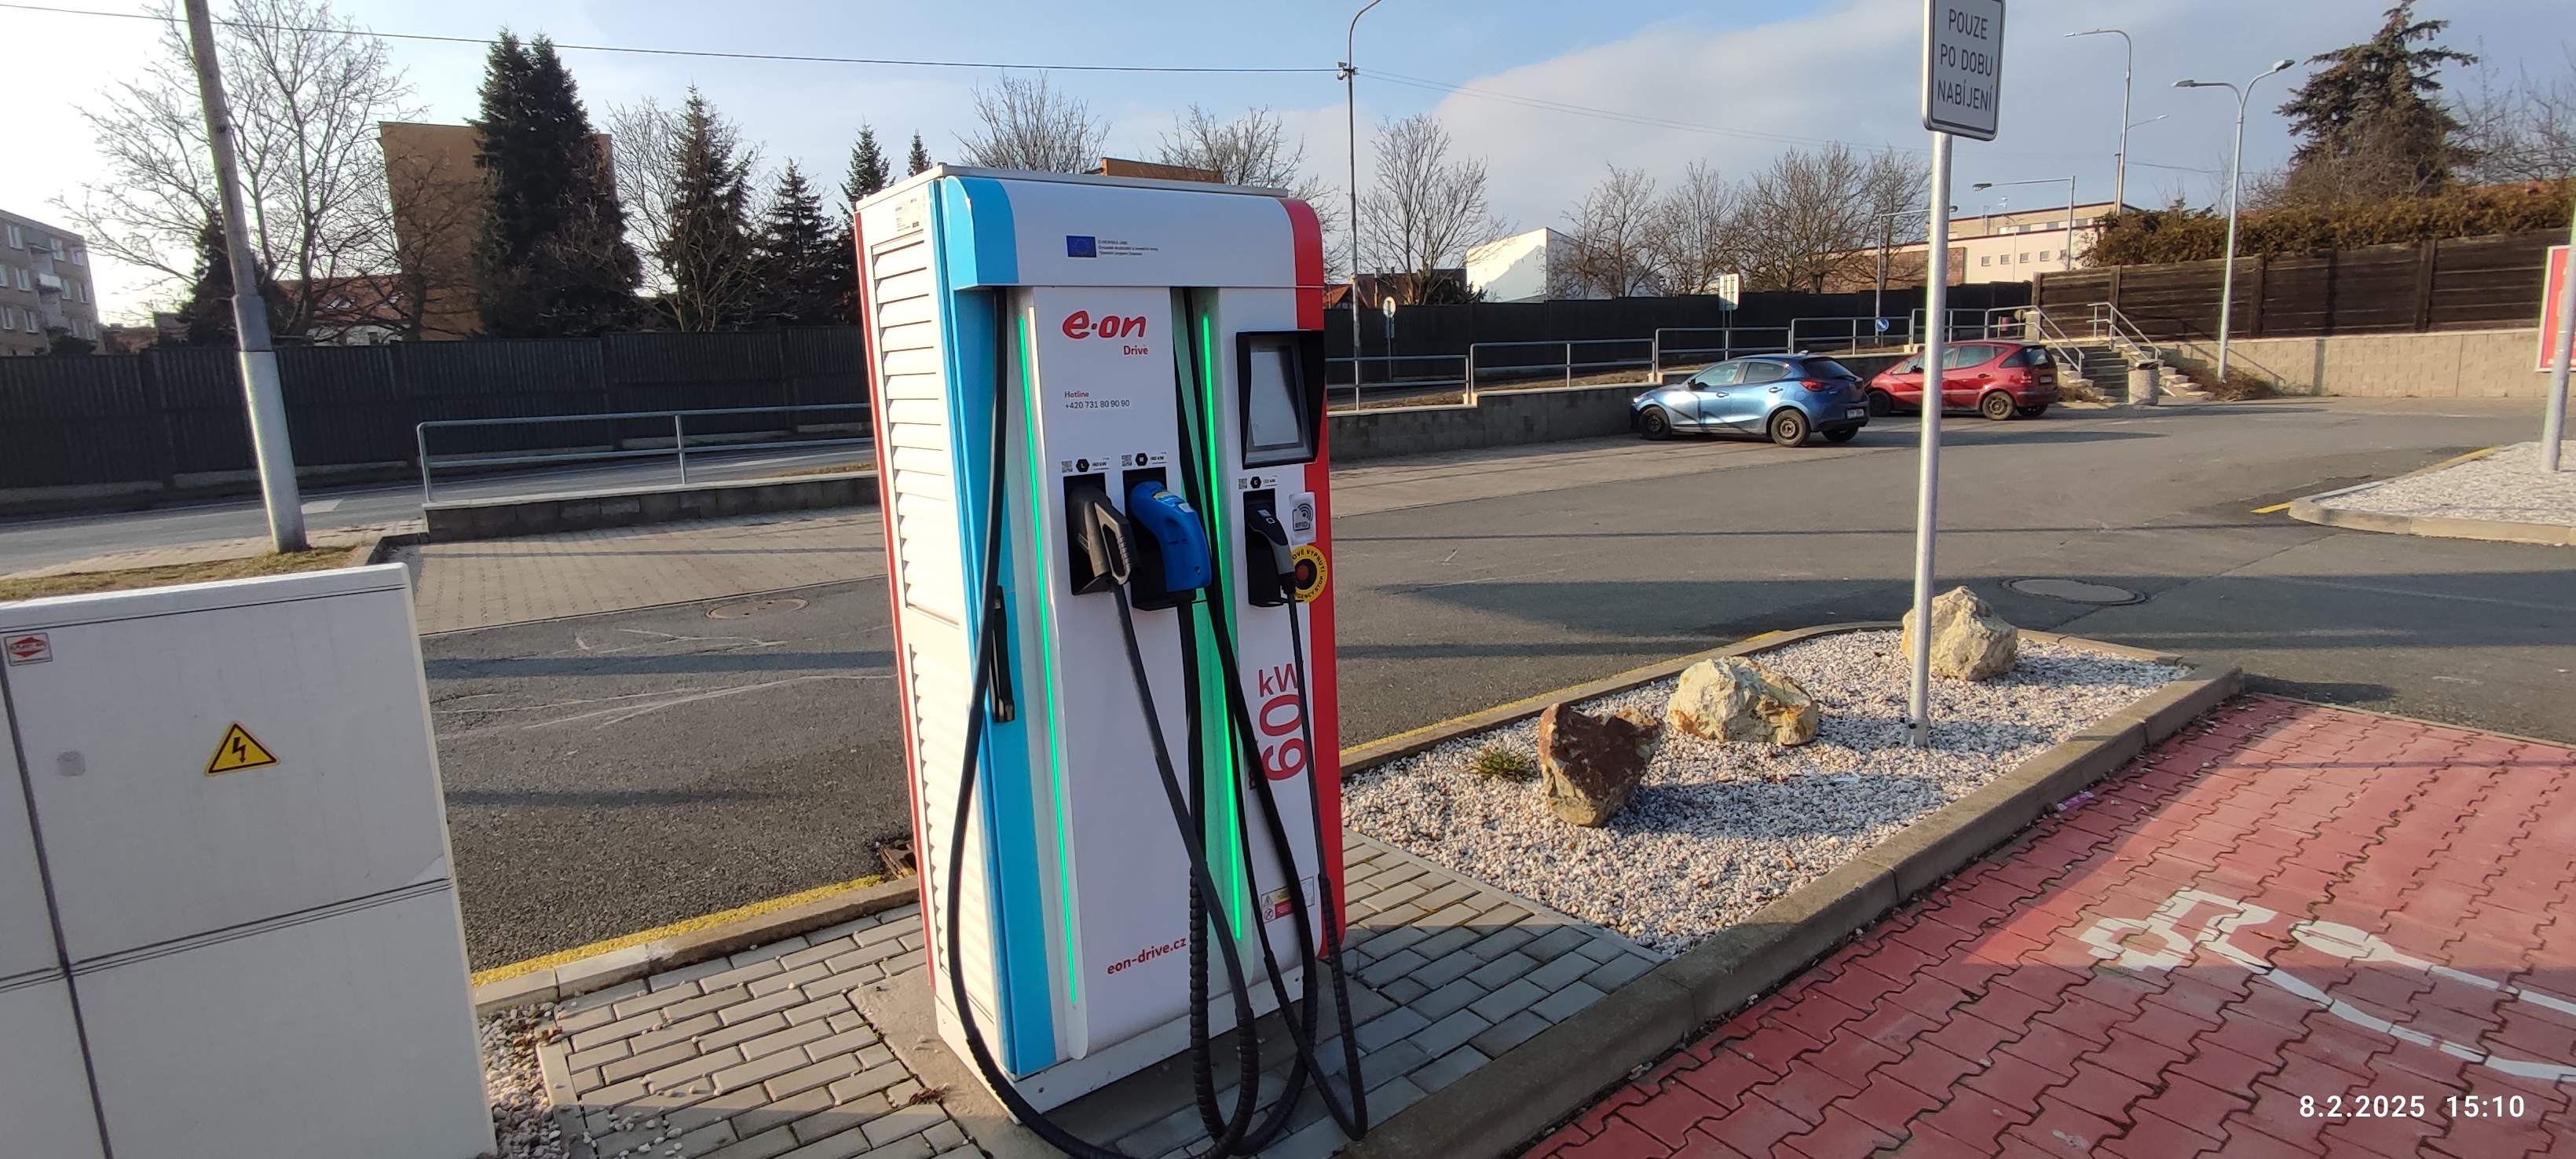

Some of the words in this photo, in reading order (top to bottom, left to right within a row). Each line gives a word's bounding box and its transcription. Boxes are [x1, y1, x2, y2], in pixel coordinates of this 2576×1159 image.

[1948, 9, 1989, 40] POUZE
[1940, 43, 1956, 68] PO
[1961, 49, 1993, 77] DOBU
[1937, 79, 1993, 112] NABÍJENÍ
[1123, 345, 1149, 356] Drive
[1100, 400, 1110, 408] 80
[1121, 399, 1130, 408] 90
[1314, 576, 1324, 592] STOP
[1258, 664, 1298, 698] kW
[1107, 938, 1187, 975] eon-drive.cz
